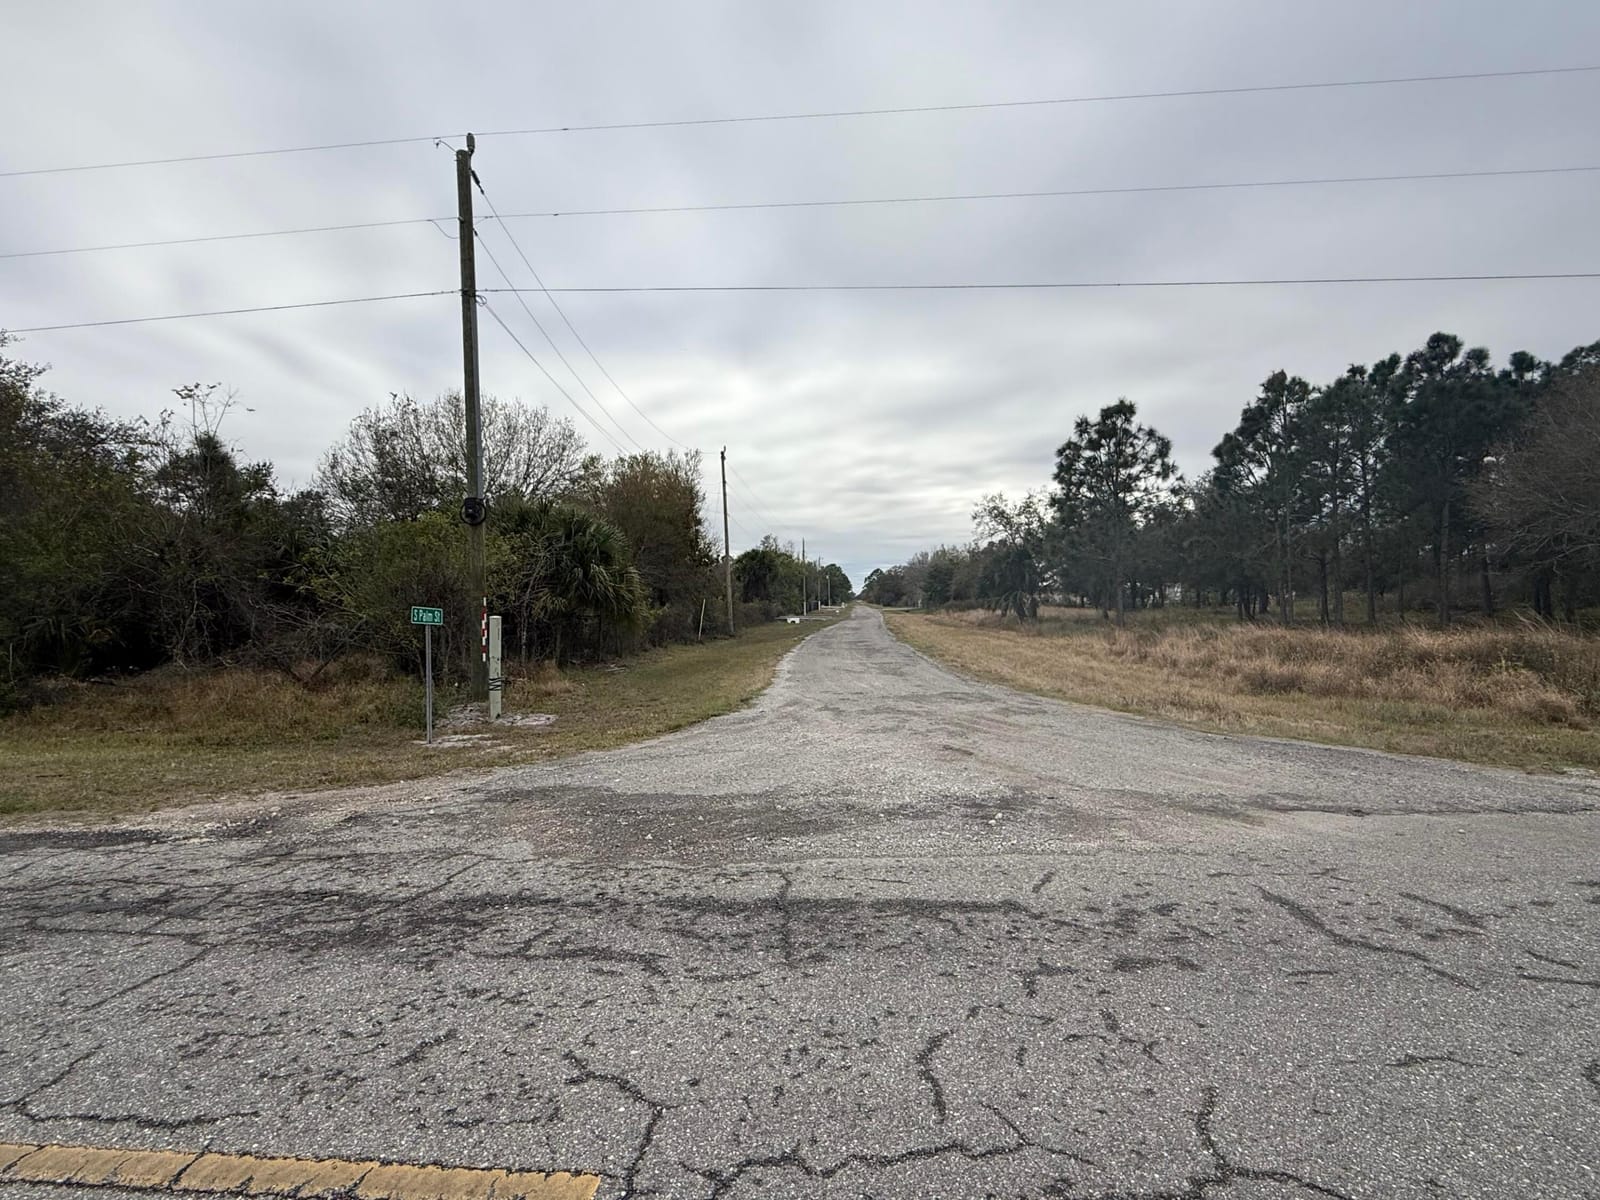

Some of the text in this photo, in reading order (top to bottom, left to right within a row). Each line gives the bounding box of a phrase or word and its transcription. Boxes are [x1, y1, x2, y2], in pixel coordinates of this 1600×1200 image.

[414, 609, 440, 622] S Palm St
